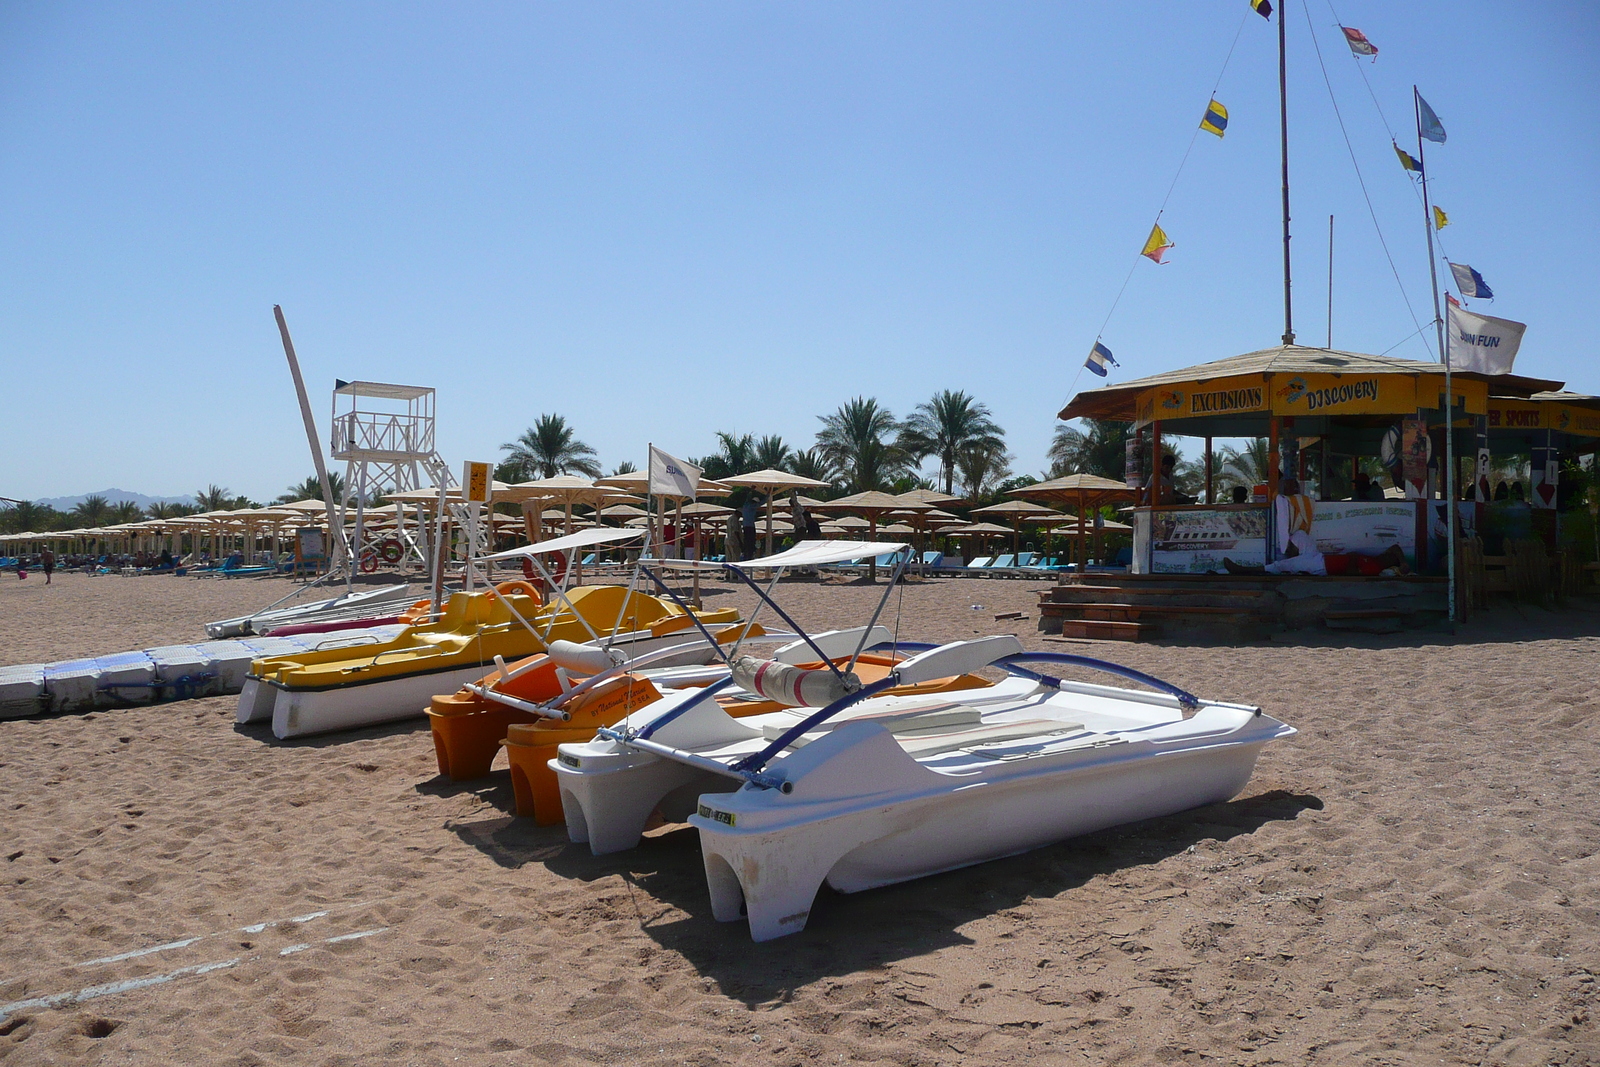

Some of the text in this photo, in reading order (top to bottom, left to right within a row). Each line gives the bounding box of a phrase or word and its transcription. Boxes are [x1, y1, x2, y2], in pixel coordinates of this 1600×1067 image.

[1477, 335, 1500, 347] FUN
[1191, 388, 1262, 412] EXCURSIONS
[1306, 379, 1378, 410] DISCOVERY
[1506, 410, 1540, 426] SPORTS
[591, 709, 599, 717] BY
[598, 694, 624, 712] National
[638, 694, 651, 704] SEA
